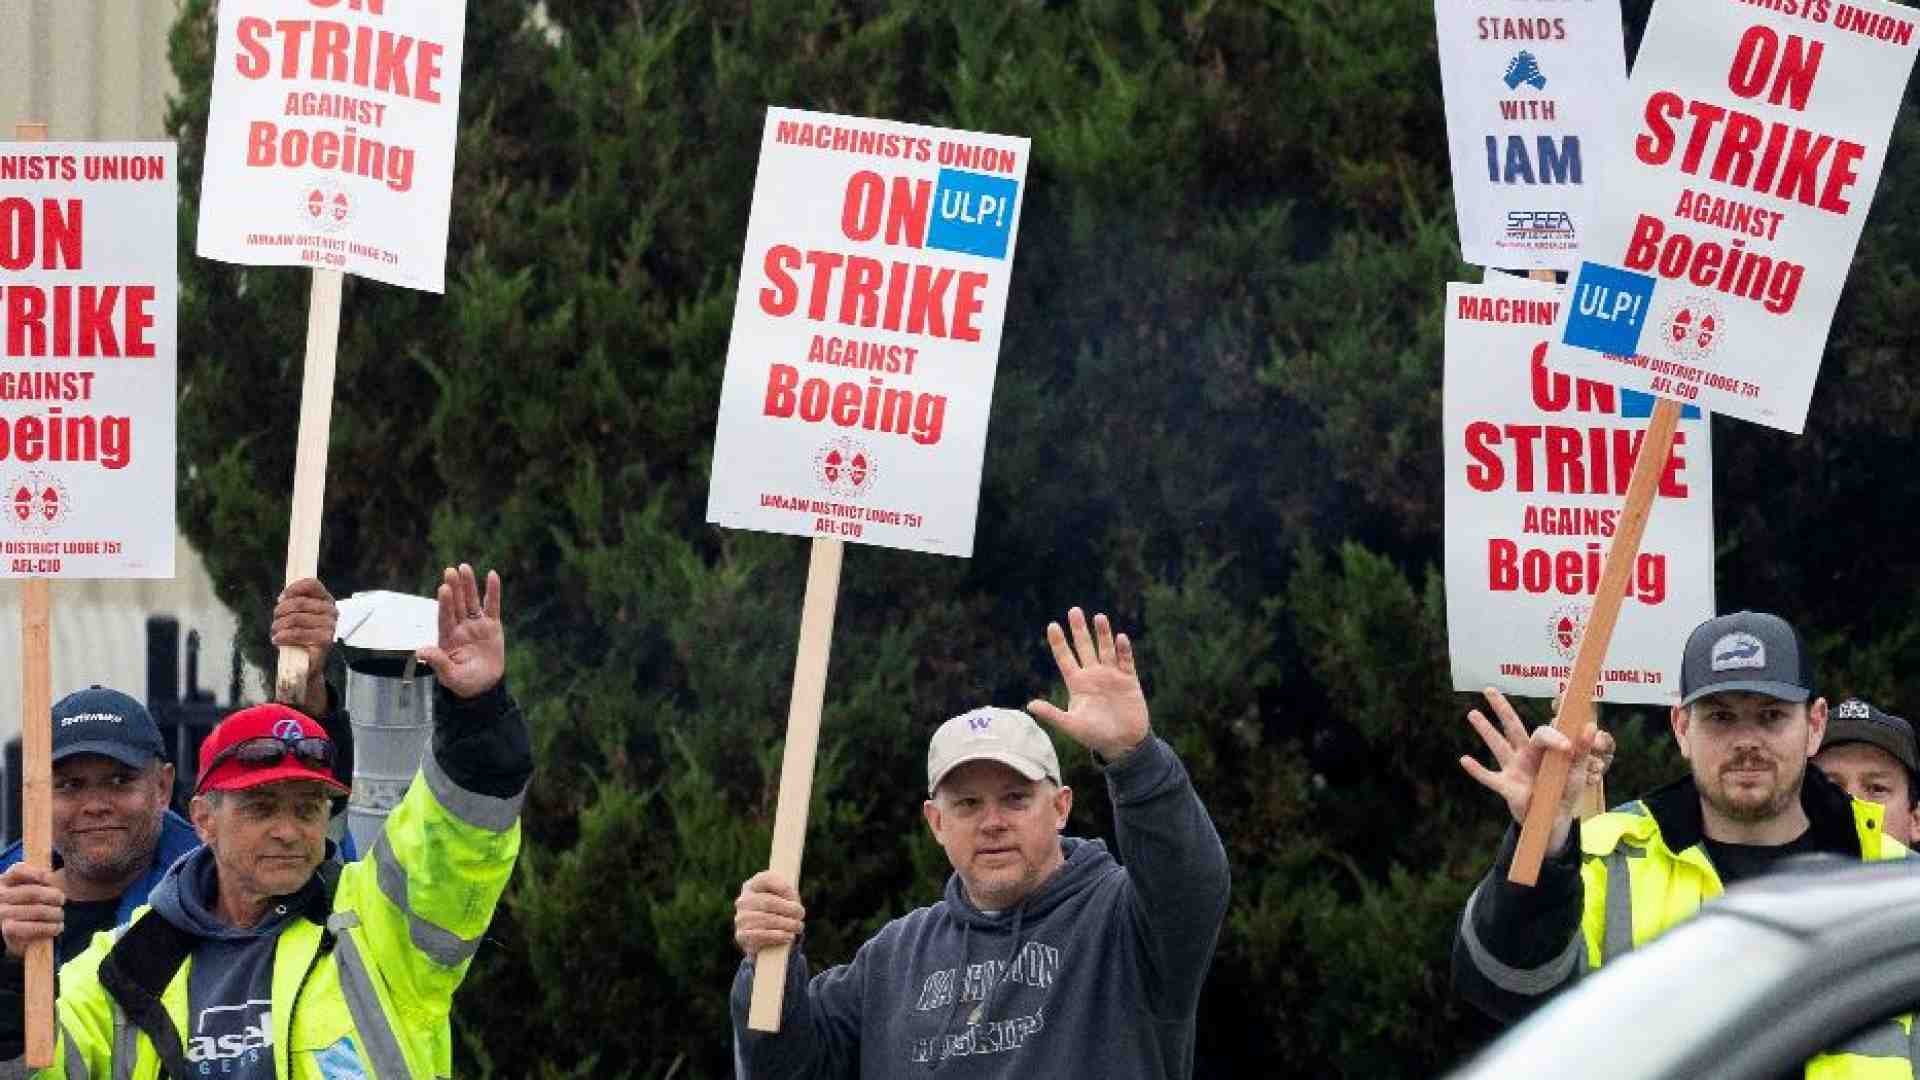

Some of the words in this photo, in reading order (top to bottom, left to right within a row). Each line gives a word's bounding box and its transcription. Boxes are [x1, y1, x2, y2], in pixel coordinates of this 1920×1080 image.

[1477, 16, 1567, 40] STANDS
[1834, 4, 1914, 46] UNION
[236, 16, 444, 104] STRIKE
[1727, 25, 1824, 112] ON
[285, 92, 386, 127] AGAINST
[1499, 100, 1555, 121] WITH
[83, 155, 165, 181] UNION
[247, 121, 415, 192] Boeing
[777, 120, 931, 163] MACHINISTS
[937, 140, 1016, 173] UNION
[1485, 135, 1583, 184] IAM
[1634, 91, 1867, 215] STRIKE
[841, 170, 932, 250] ON
[940, 188, 1008, 227] ULP!
[1674, 189, 1784, 241] AGAINST
[0, 197, 83, 270] ON
[1623, 213, 1806, 316] Boeing
[759, 244, 988, 343] STRIKE
[1580, 283, 1642, 326] ULP!
[0, 283, 156, 358] RIKE
[808, 335, 919, 375] AGAINST
[1650, 358, 1704, 384] DISTRICT
[1741, 382, 1761, 398] 751
[762, 363, 947, 445] Boeing
[1465, 421, 1689, 498] STRIKE
[811, 501, 864, 521] DISTRICT
[903, 513, 923, 528] 751
[1523, 505, 1620, 537] AGAINS
[6, 542, 59, 554] DISTRICT
[1489, 539, 1667, 604] Boeig
[968, 717, 991, 730] W
